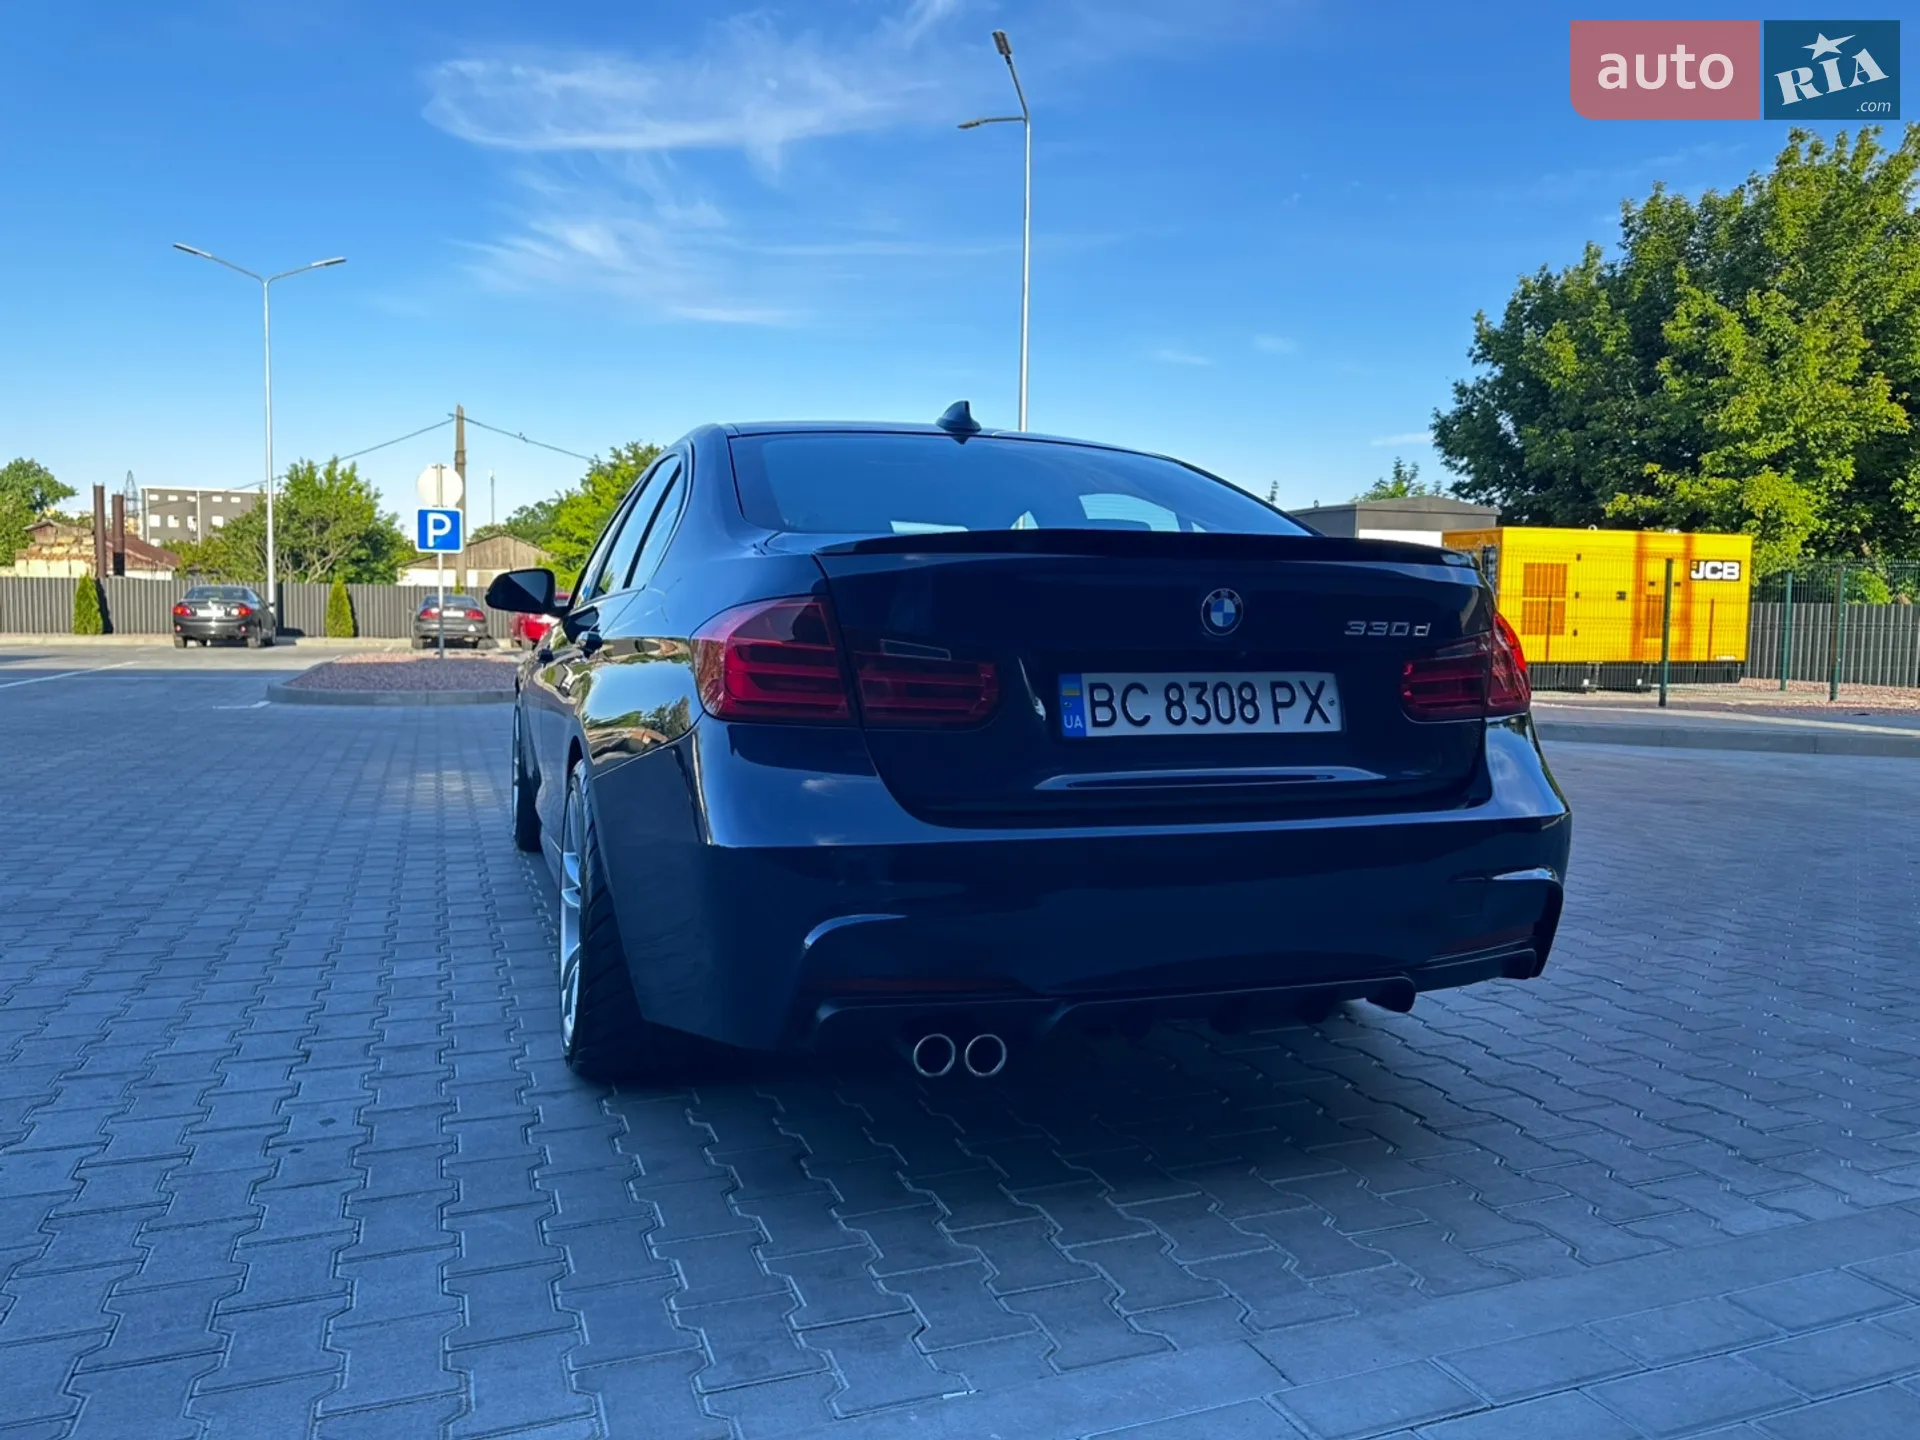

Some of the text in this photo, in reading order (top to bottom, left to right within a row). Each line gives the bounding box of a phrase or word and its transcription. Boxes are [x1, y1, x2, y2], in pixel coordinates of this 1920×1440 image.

[427, 513, 452, 547] P
[1690, 561, 1740, 580] JCB
[1344, 621, 1431, 636] 330d
[1088, 680, 1332, 728] BC 8308 PX
[1063, 714, 1084, 729] UA
